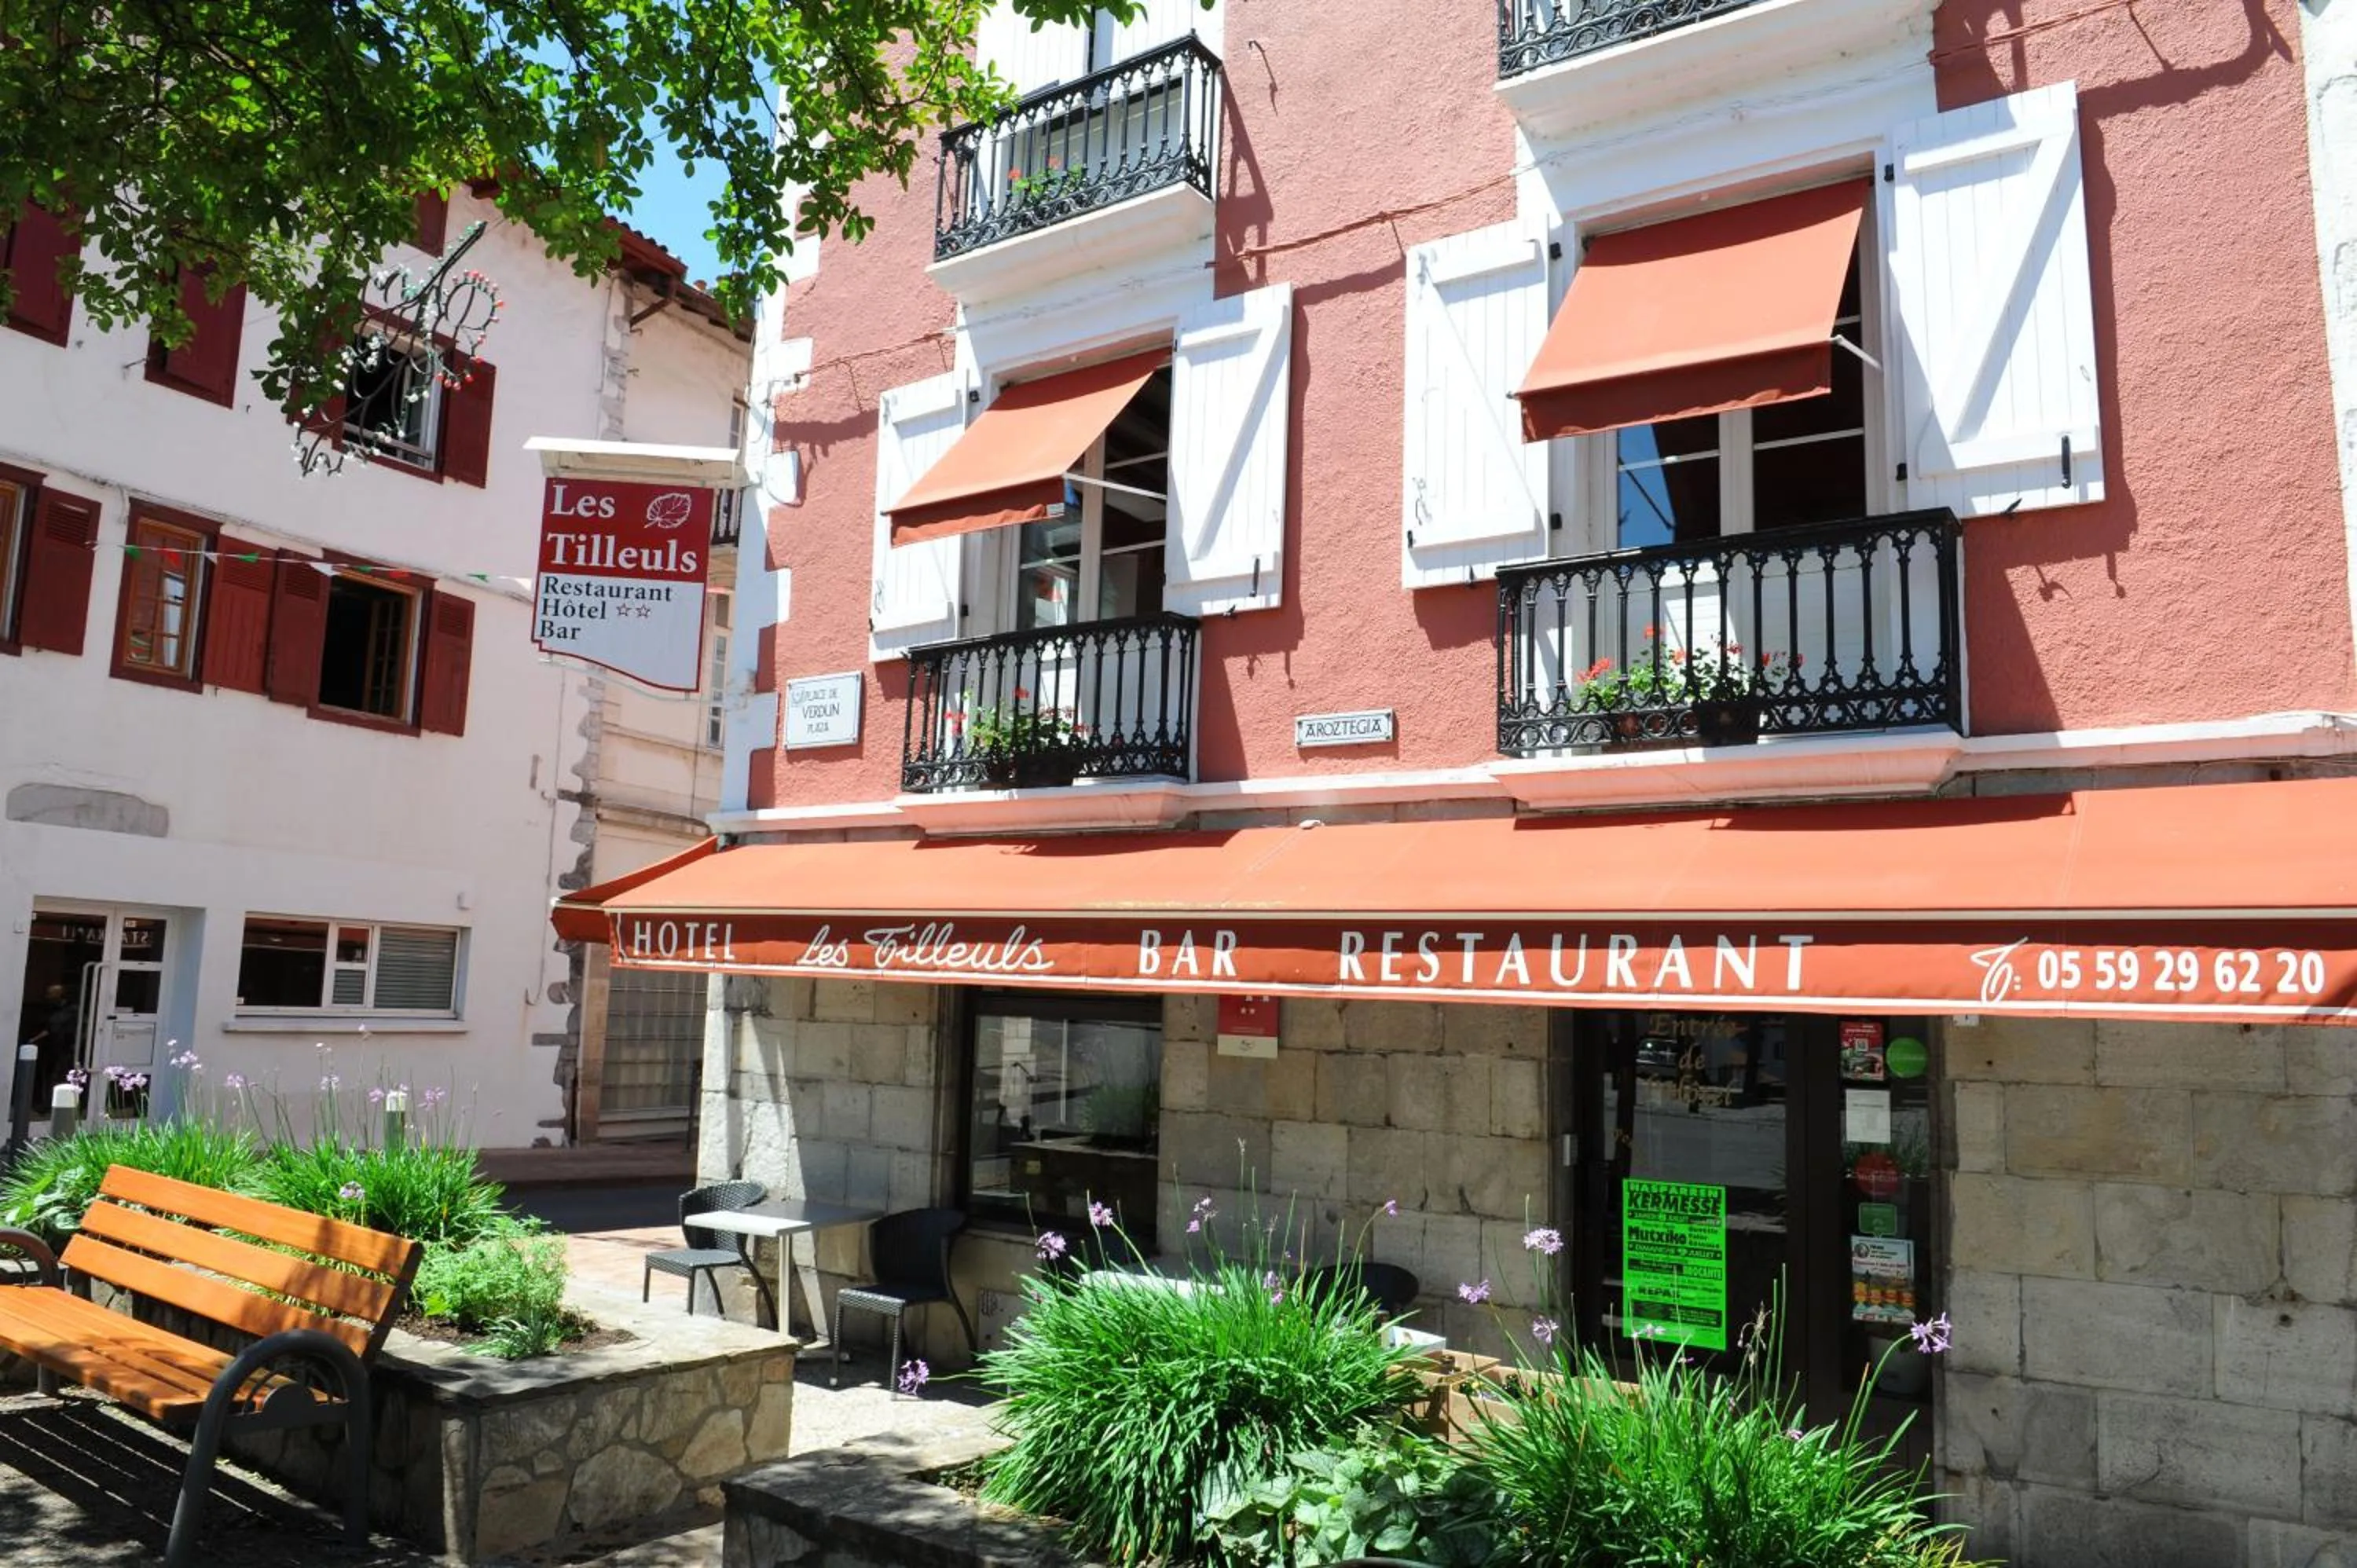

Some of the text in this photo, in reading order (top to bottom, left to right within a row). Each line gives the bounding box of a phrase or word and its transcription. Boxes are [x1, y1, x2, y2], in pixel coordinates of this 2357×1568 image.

[550, 484, 615, 518] Les
[546, 533, 697, 573] Tilleuls
[544, 576, 673, 603] Restaurant
[541, 599, 607, 620] Hôtel
[539, 620, 581, 640] Bar
[802, 702, 840, 719] VERDUN
[1305, 718, 1382, 738] AROZTEGIA
[633, 920, 735, 960] HOTEL
[864, 921, 1055, 971] Tilleuls
[1138, 929, 1814, 991] BAR RESTAURANT
[2038, 950, 2081, 990] 05
[2095, 951, 2139, 991] 59
[2153, 951, 2199, 991] 29
[2214, 951, 2261, 994] 62
[2276, 951, 2325, 995] 20
[1678, 1042, 1706, 1070] de
[1628, 1192, 1722, 1215] KERMESSE
